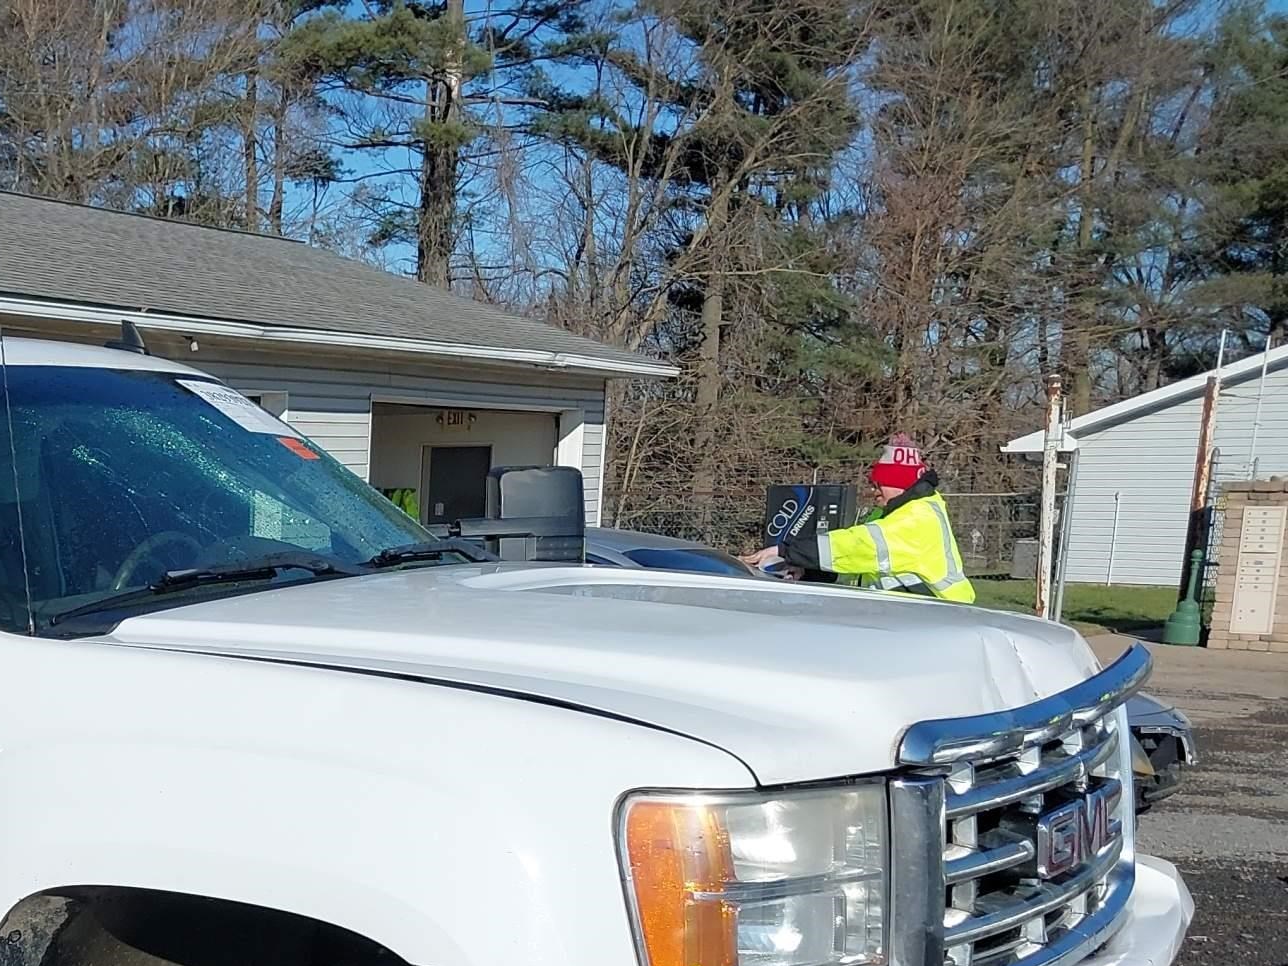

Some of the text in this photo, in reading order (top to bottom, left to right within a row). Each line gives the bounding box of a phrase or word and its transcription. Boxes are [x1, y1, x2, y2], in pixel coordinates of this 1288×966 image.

[447, 411, 464, 425] EXIT
[767, 499, 798, 537] COLD
[789, 505, 815, 537] DRINKS
[1048, 785, 1122, 874] GMC
